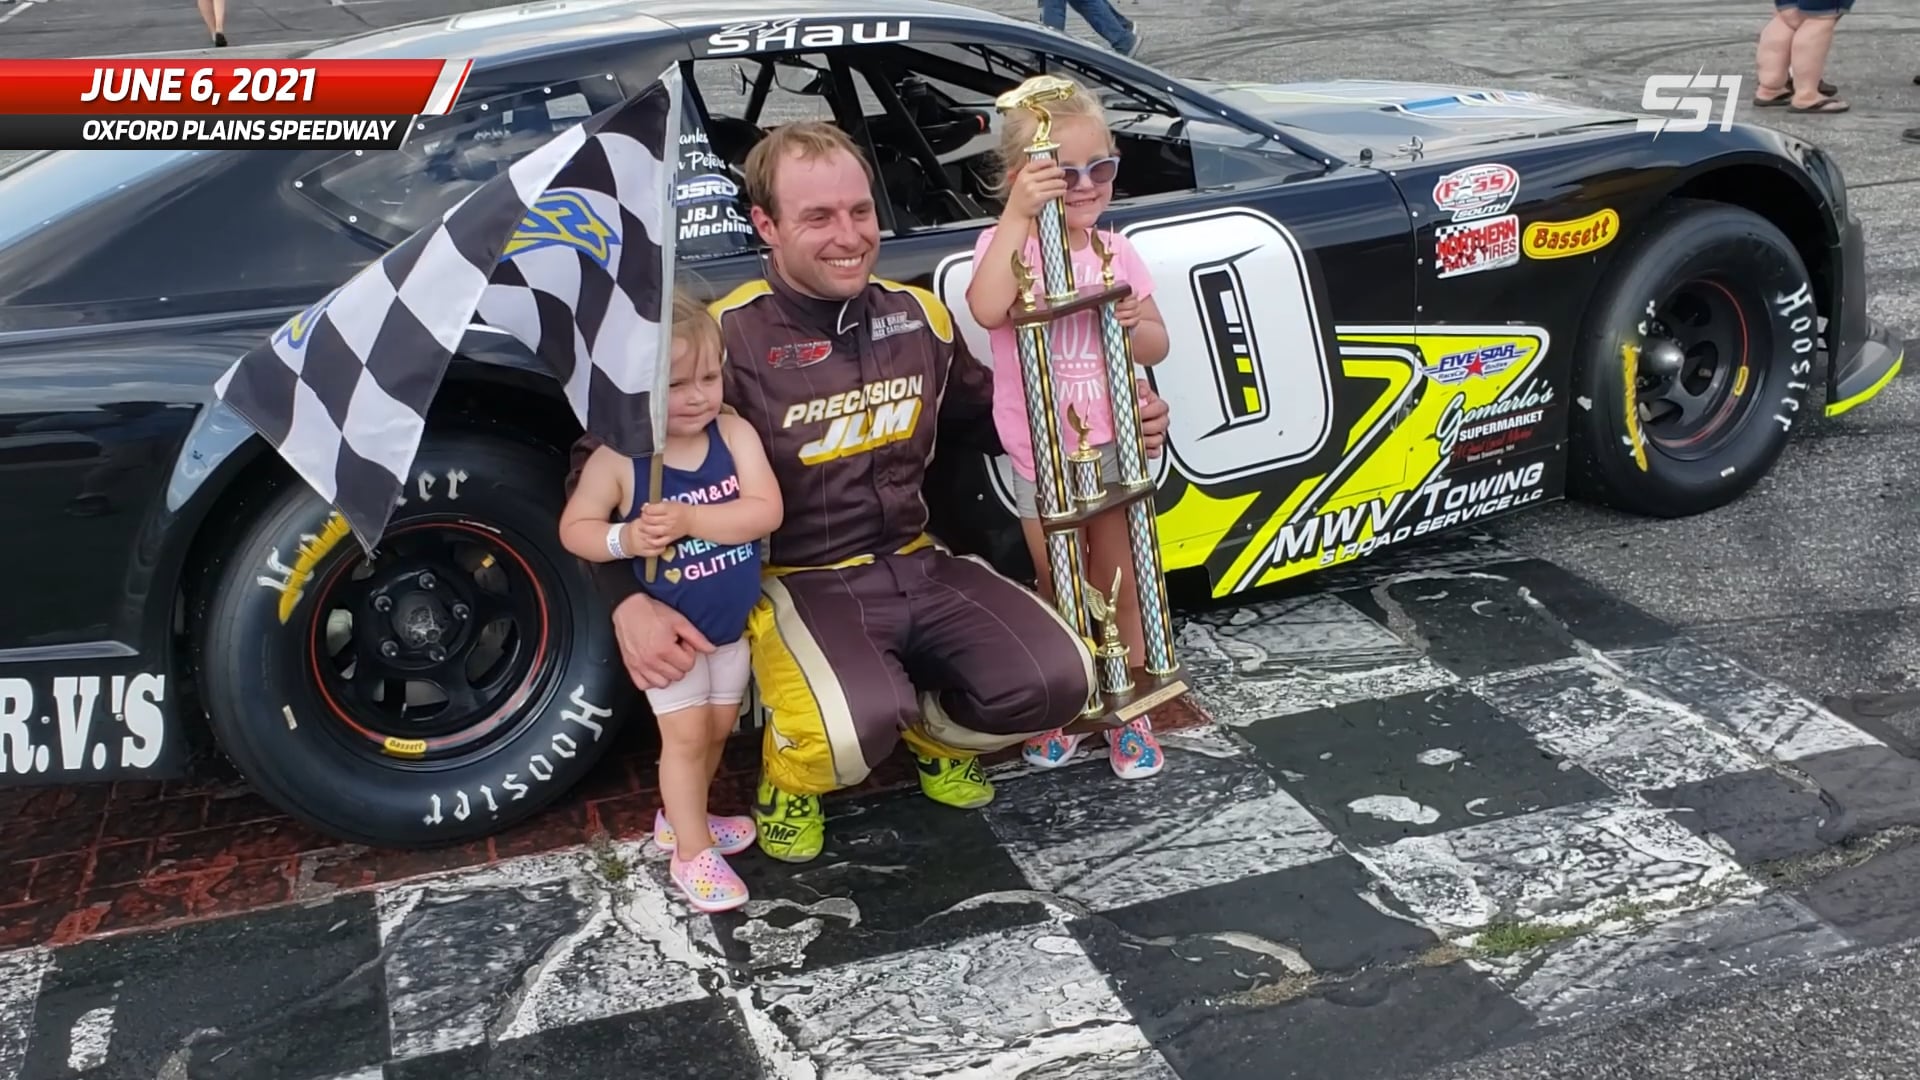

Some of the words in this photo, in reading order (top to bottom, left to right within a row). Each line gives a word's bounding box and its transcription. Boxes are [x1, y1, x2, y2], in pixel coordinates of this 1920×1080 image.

[681, 205, 718, 224] JBJ
[1457, 202, 1507, 219] SOUTH
[680, 218, 753, 240] Machine
[1437, 218, 1517, 257] NORTHERN
[1533, 216, 1610, 250] Bassett
[1482, 239, 1517, 262] TIRES
[1439, 351, 1475, 372] FIVE
[1481, 344, 1515, 361] STAR
[1775, 282, 1813, 432] Hoosier
[782, 374, 923, 429] PRECISION
[1436, 377, 1554, 455] Gomarlo's
[798, 397, 922, 466] JLM
[1459, 410, 1544, 441] SUPERMARKET
[709, 485, 722, 501] &
[1272, 492, 1404, 563] MWV
[1340, 526, 1410, 560] ROAD
[1413, 496, 1509, 536] SERVICE
[1515, 488, 1544, 504] LLC
[684, 543, 754, 580] GLITTER
[387, 739, 424, 751] Bassett
[423, 684, 613, 826] Hoosier
[761, 822, 799, 840] OMP
